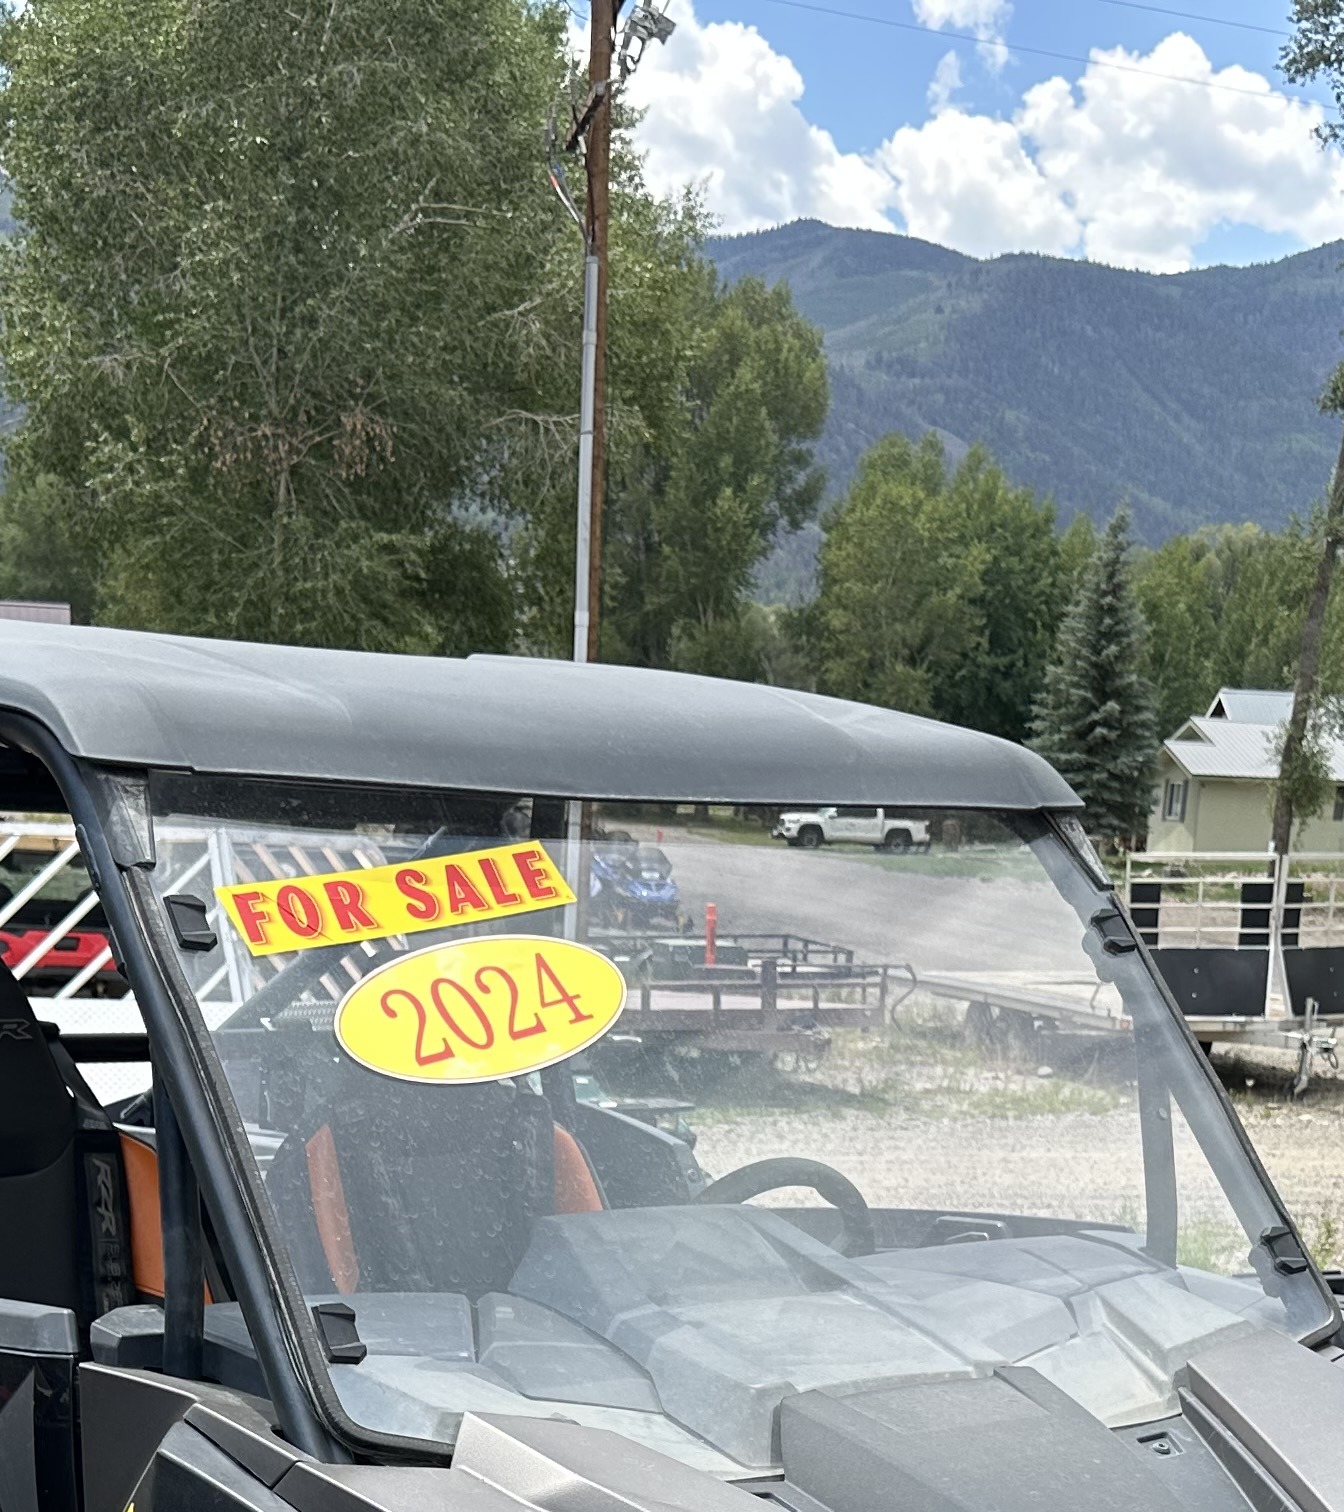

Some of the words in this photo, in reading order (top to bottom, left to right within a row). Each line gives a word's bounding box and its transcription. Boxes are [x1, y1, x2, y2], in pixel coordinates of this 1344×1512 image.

[232, 880, 381, 945] FOR
[395, 849, 556, 921] SALE
[380, 952, 594, 1067] 2024
